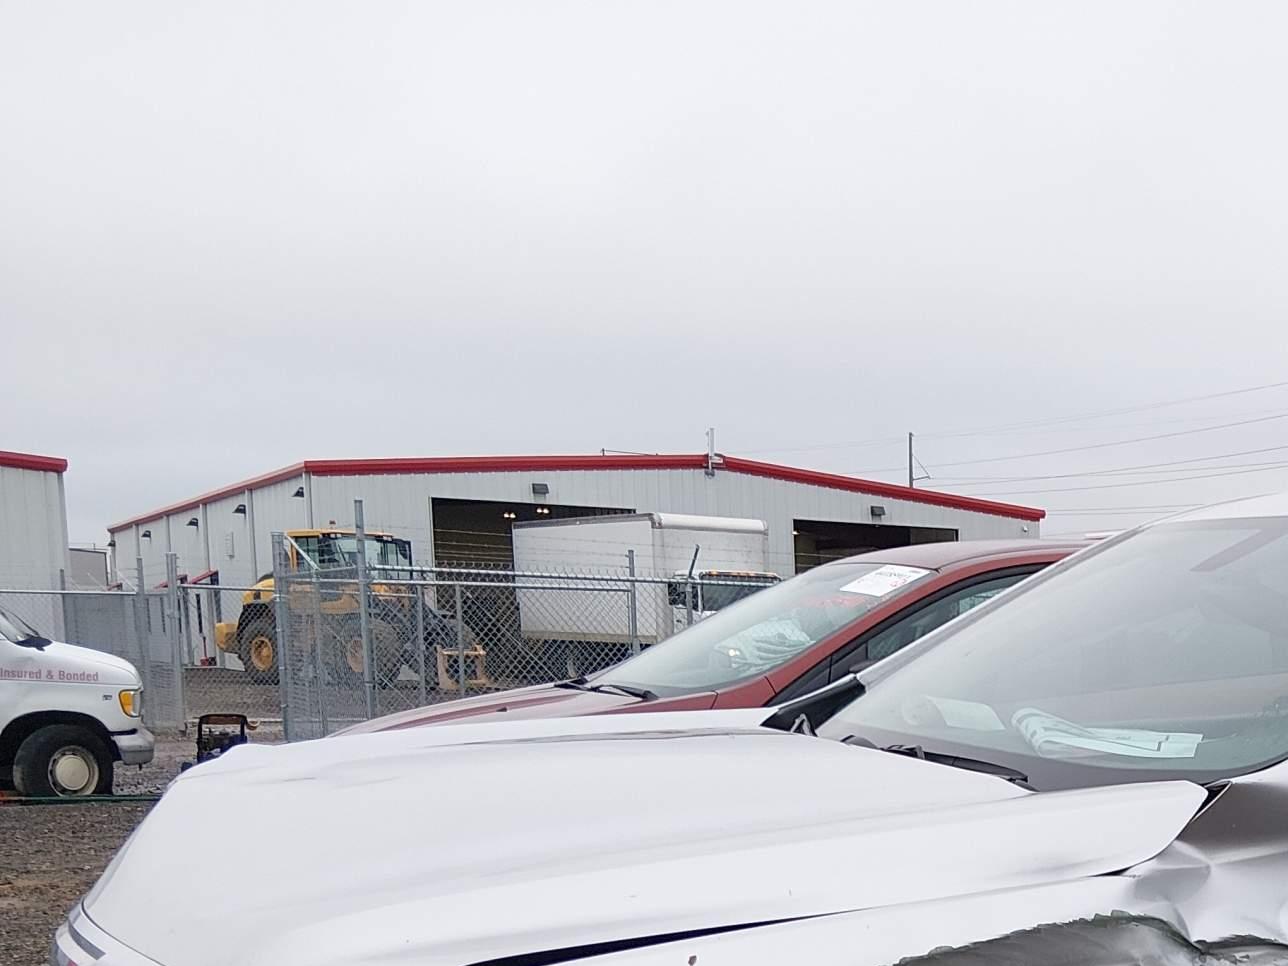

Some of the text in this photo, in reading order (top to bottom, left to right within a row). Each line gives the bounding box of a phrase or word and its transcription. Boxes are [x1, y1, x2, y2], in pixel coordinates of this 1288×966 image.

[0, 667, 99, 682] Insured & Bonded
